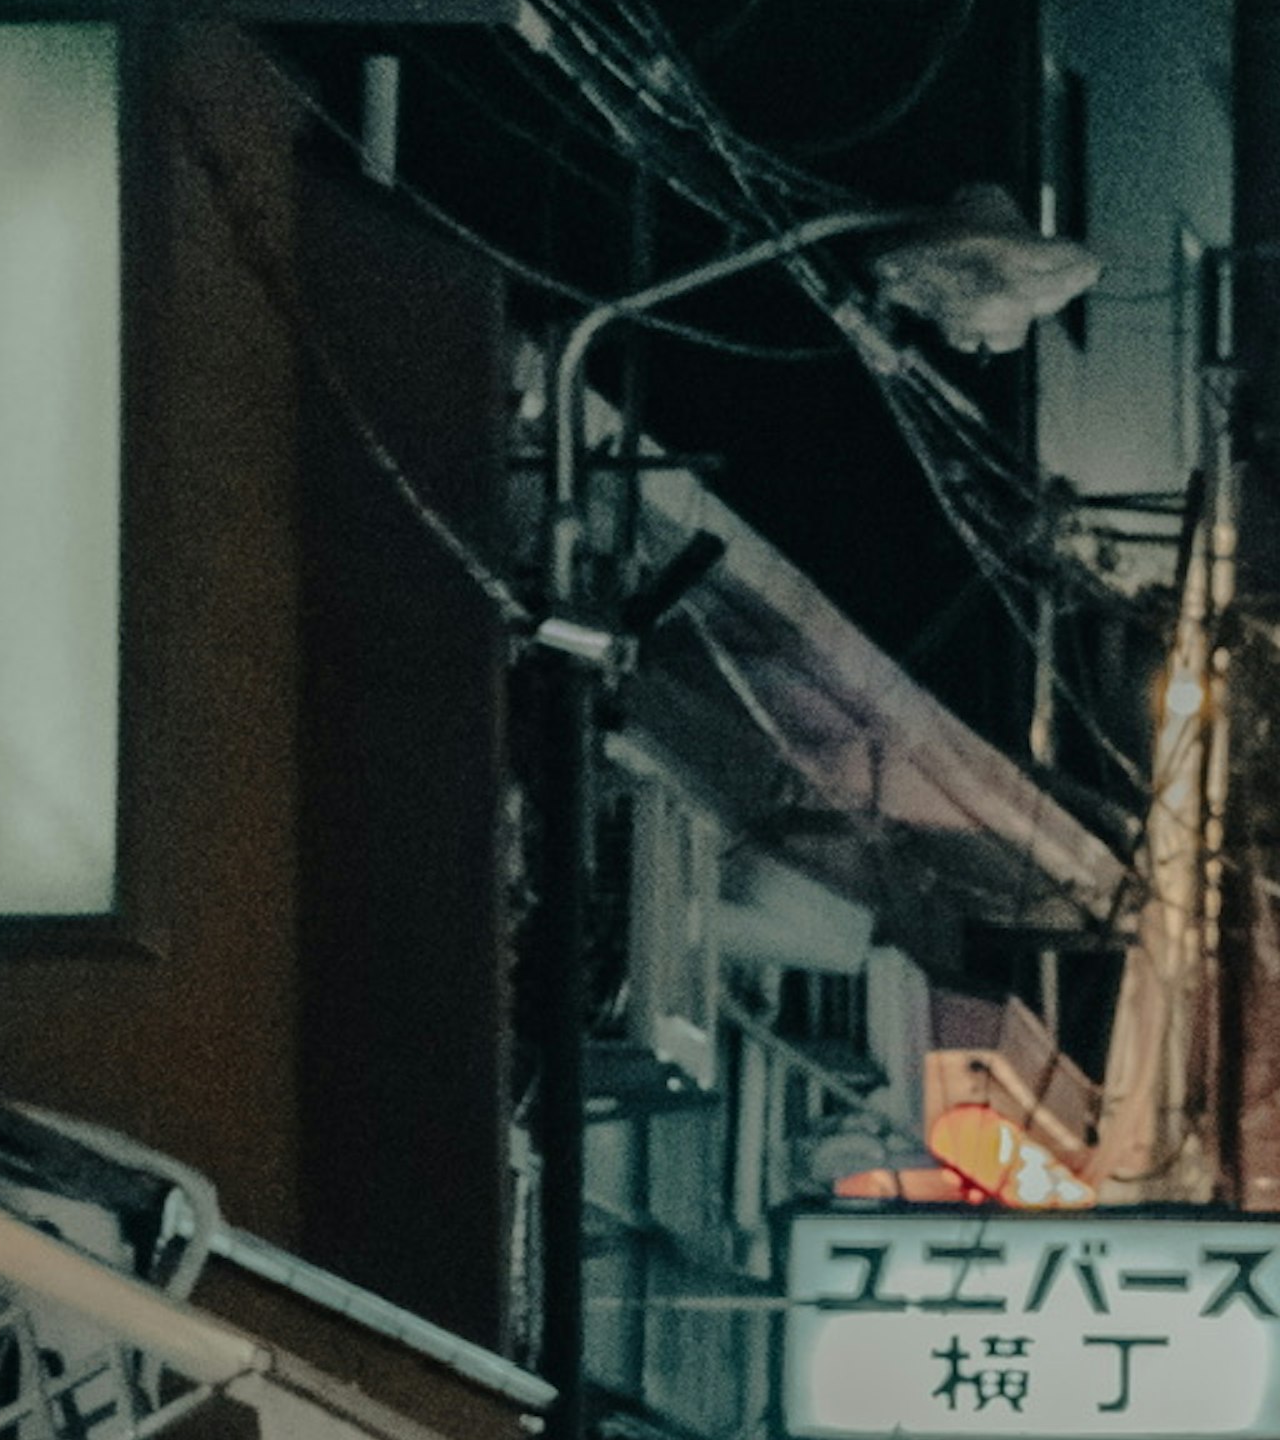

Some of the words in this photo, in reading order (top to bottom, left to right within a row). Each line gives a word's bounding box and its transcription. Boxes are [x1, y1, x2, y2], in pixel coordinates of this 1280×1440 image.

[816, 1238, 1280, 1319] ユニバース
[930, 1333, 1171, 1414] 横丁
